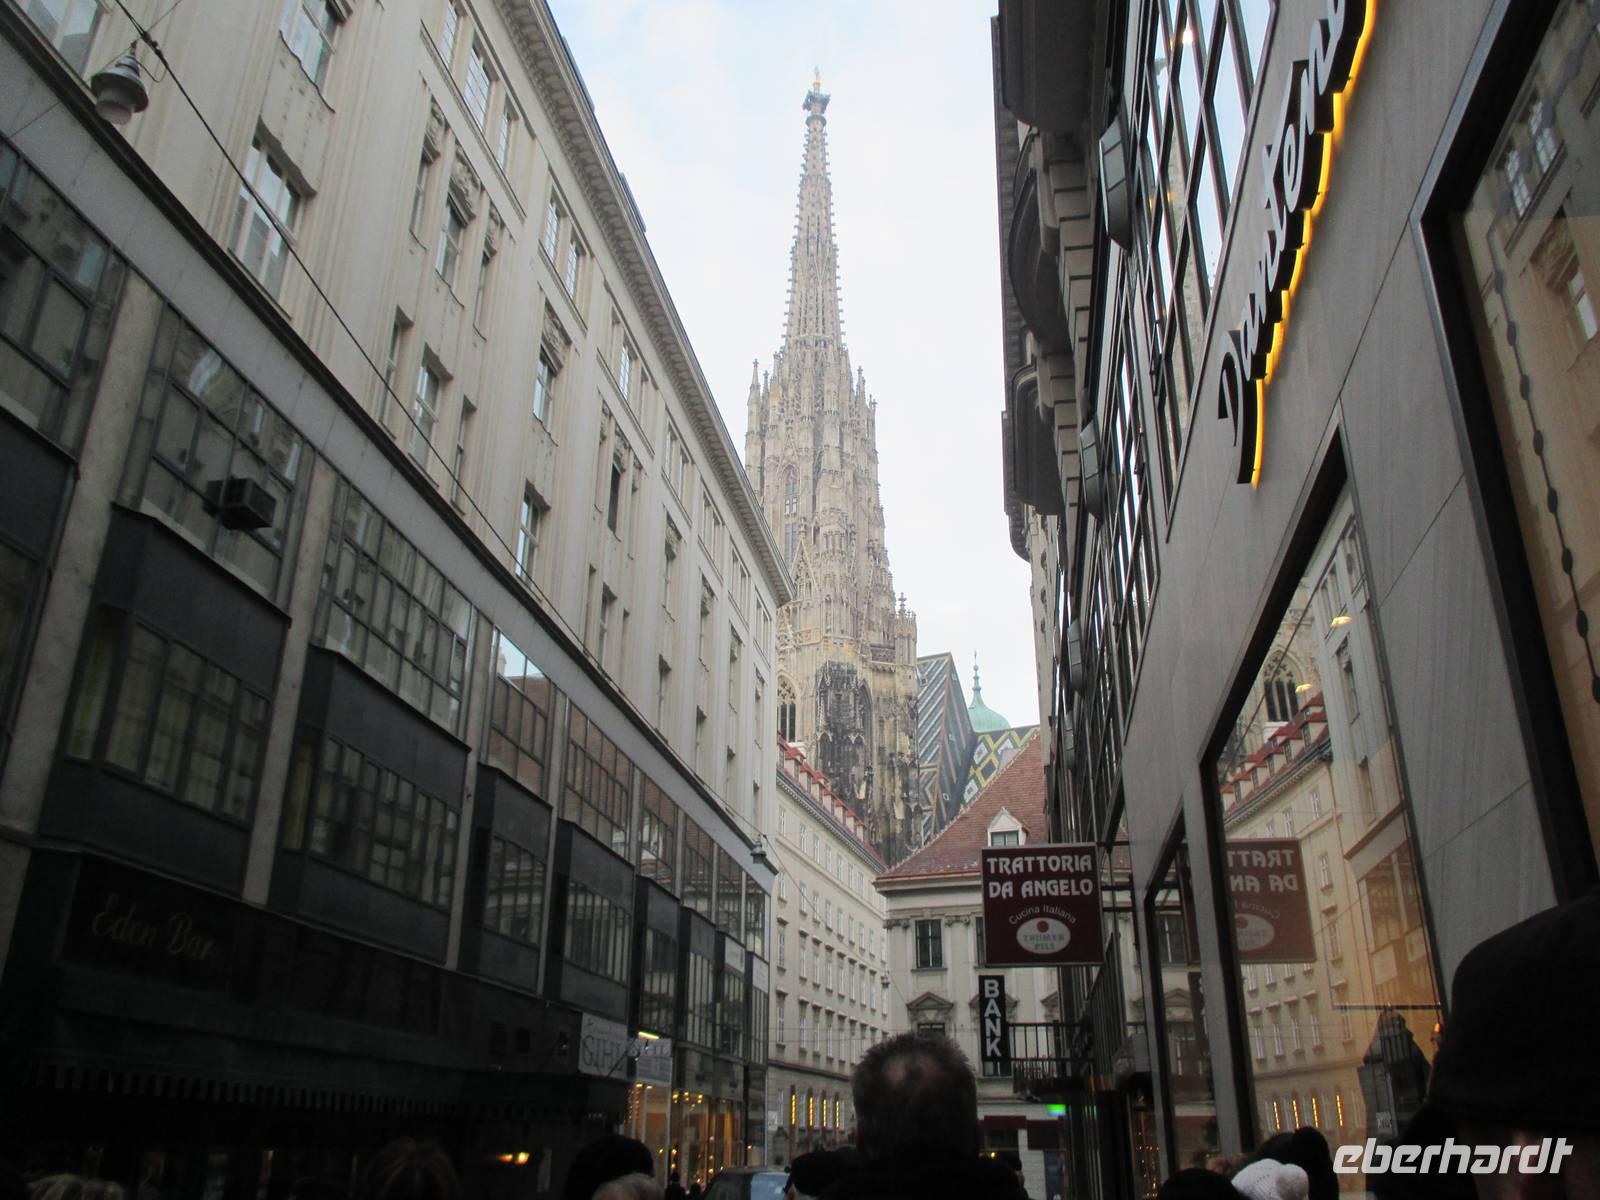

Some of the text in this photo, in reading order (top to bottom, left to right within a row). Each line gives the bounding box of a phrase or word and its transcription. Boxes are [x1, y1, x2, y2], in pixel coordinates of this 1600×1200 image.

[1217, 0, 1364, 484] Danten
[986, 854, 1093, 876] TRATTORIA
[988, 878, 1094, 899] DA ANGELO
[1008, 904, 1077, 925] Cucina Italiana
[983, 979, 1002, 1057] BANK
